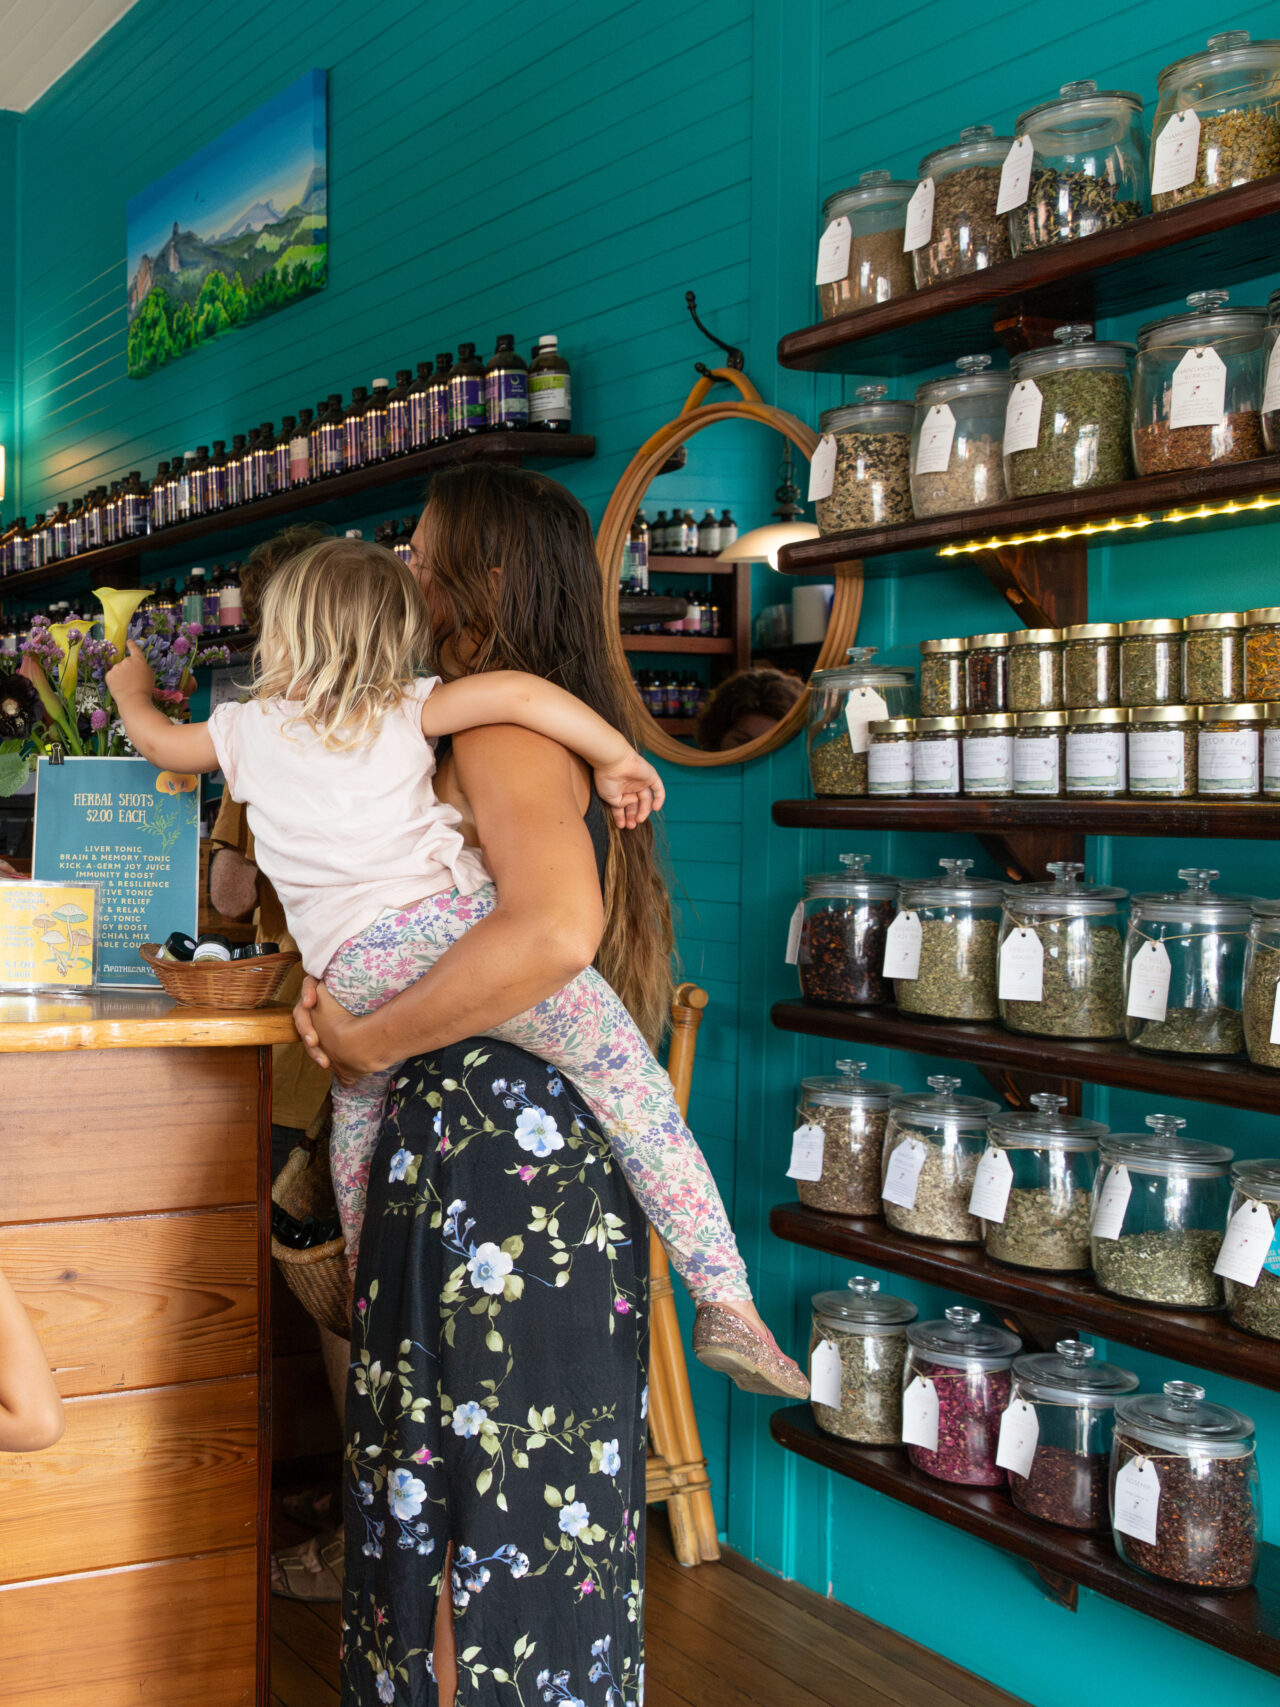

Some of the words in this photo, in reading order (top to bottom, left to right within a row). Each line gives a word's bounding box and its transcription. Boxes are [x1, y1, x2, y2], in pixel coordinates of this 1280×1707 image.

[1202, 737, 1225, 747] ETOX
[73, 793, 113, 806] HERBAL
[119, 793, 154, 807] SHOTS
[119, 809, 146, 823] EACH
[85, 845, 111, 853] LIVER
[100, 854, 139, 862] MEMORY
[143, 855, 171, 863] TONIC
[59, 862, 121, 870] KICK-A-GERM
[124, 863, 142, 871] JOY
[75, 871, 121, 879] IMMUNITY
[118, 881, 169, 889] RESILIENCE
[126, 889, 154, 897] TONIC
[116, 906, 146, 914] RELAX
